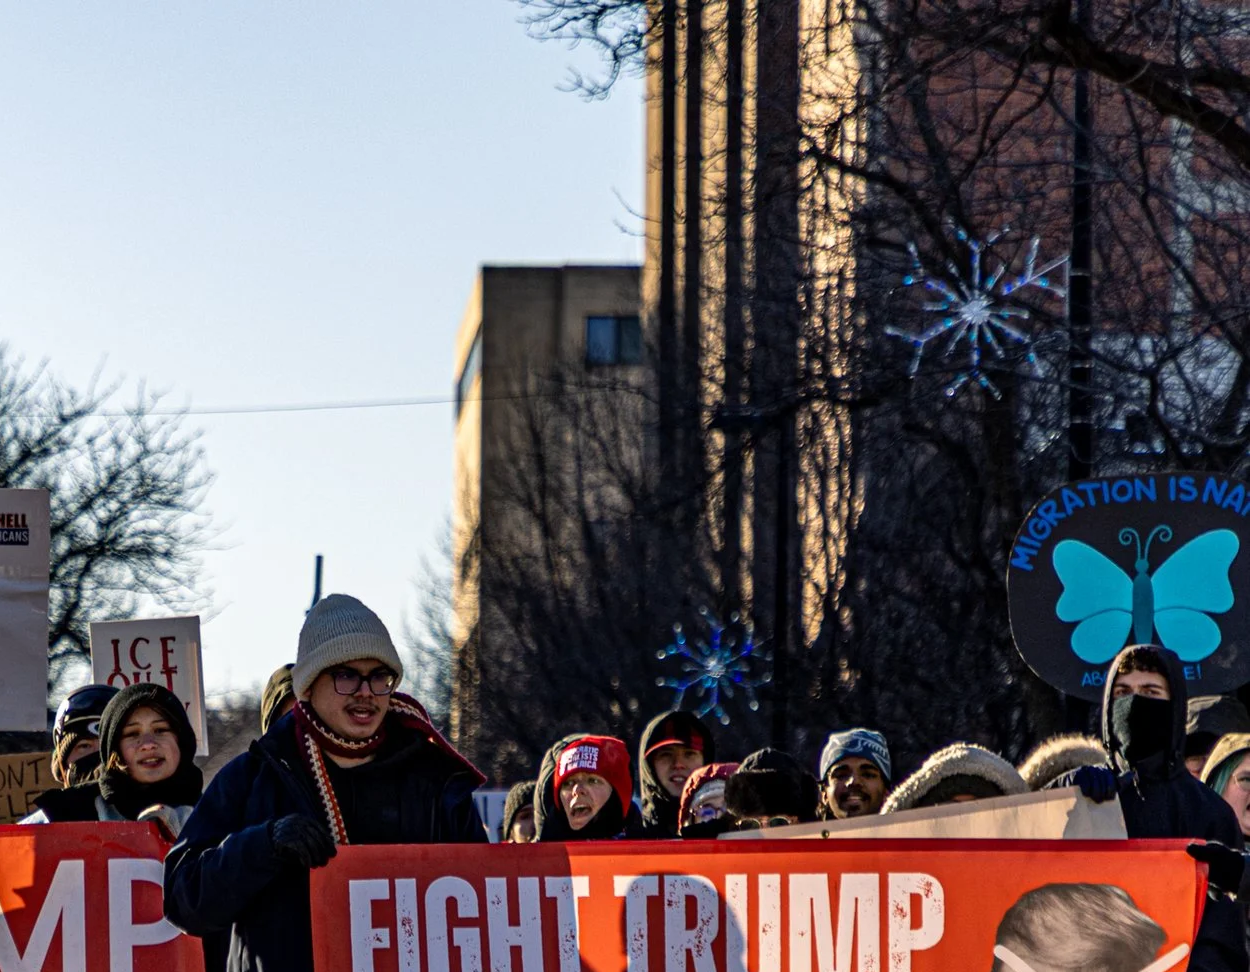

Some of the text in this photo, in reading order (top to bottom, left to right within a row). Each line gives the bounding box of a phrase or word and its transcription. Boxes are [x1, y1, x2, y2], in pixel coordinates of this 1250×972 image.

[1010, 476, 1158, 572] MIGRATION
[1168, 475, 1198, 502] IS
[110, 637, 178, 671] ICE
